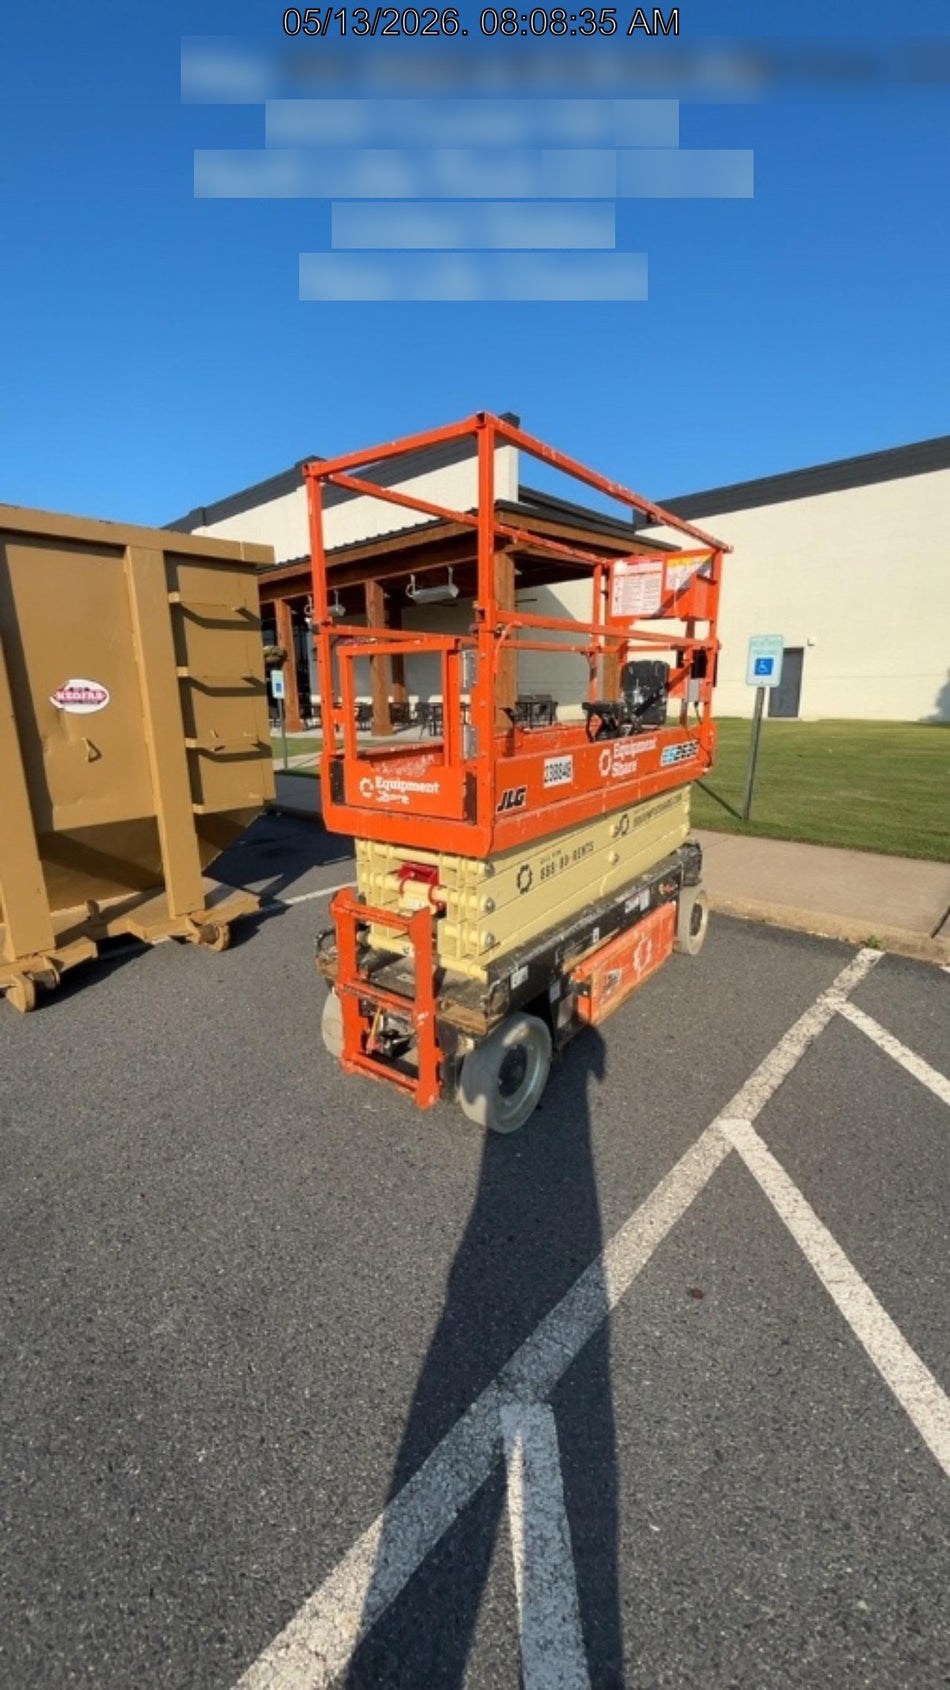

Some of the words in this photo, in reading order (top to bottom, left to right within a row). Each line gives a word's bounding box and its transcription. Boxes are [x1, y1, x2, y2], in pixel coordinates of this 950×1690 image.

[613, 737, 657, 761] Equipment
[612, 760, 638, 778] Share
[375, 775, 440, 795] Equipment
[496, 786, 527, 813] JLG
